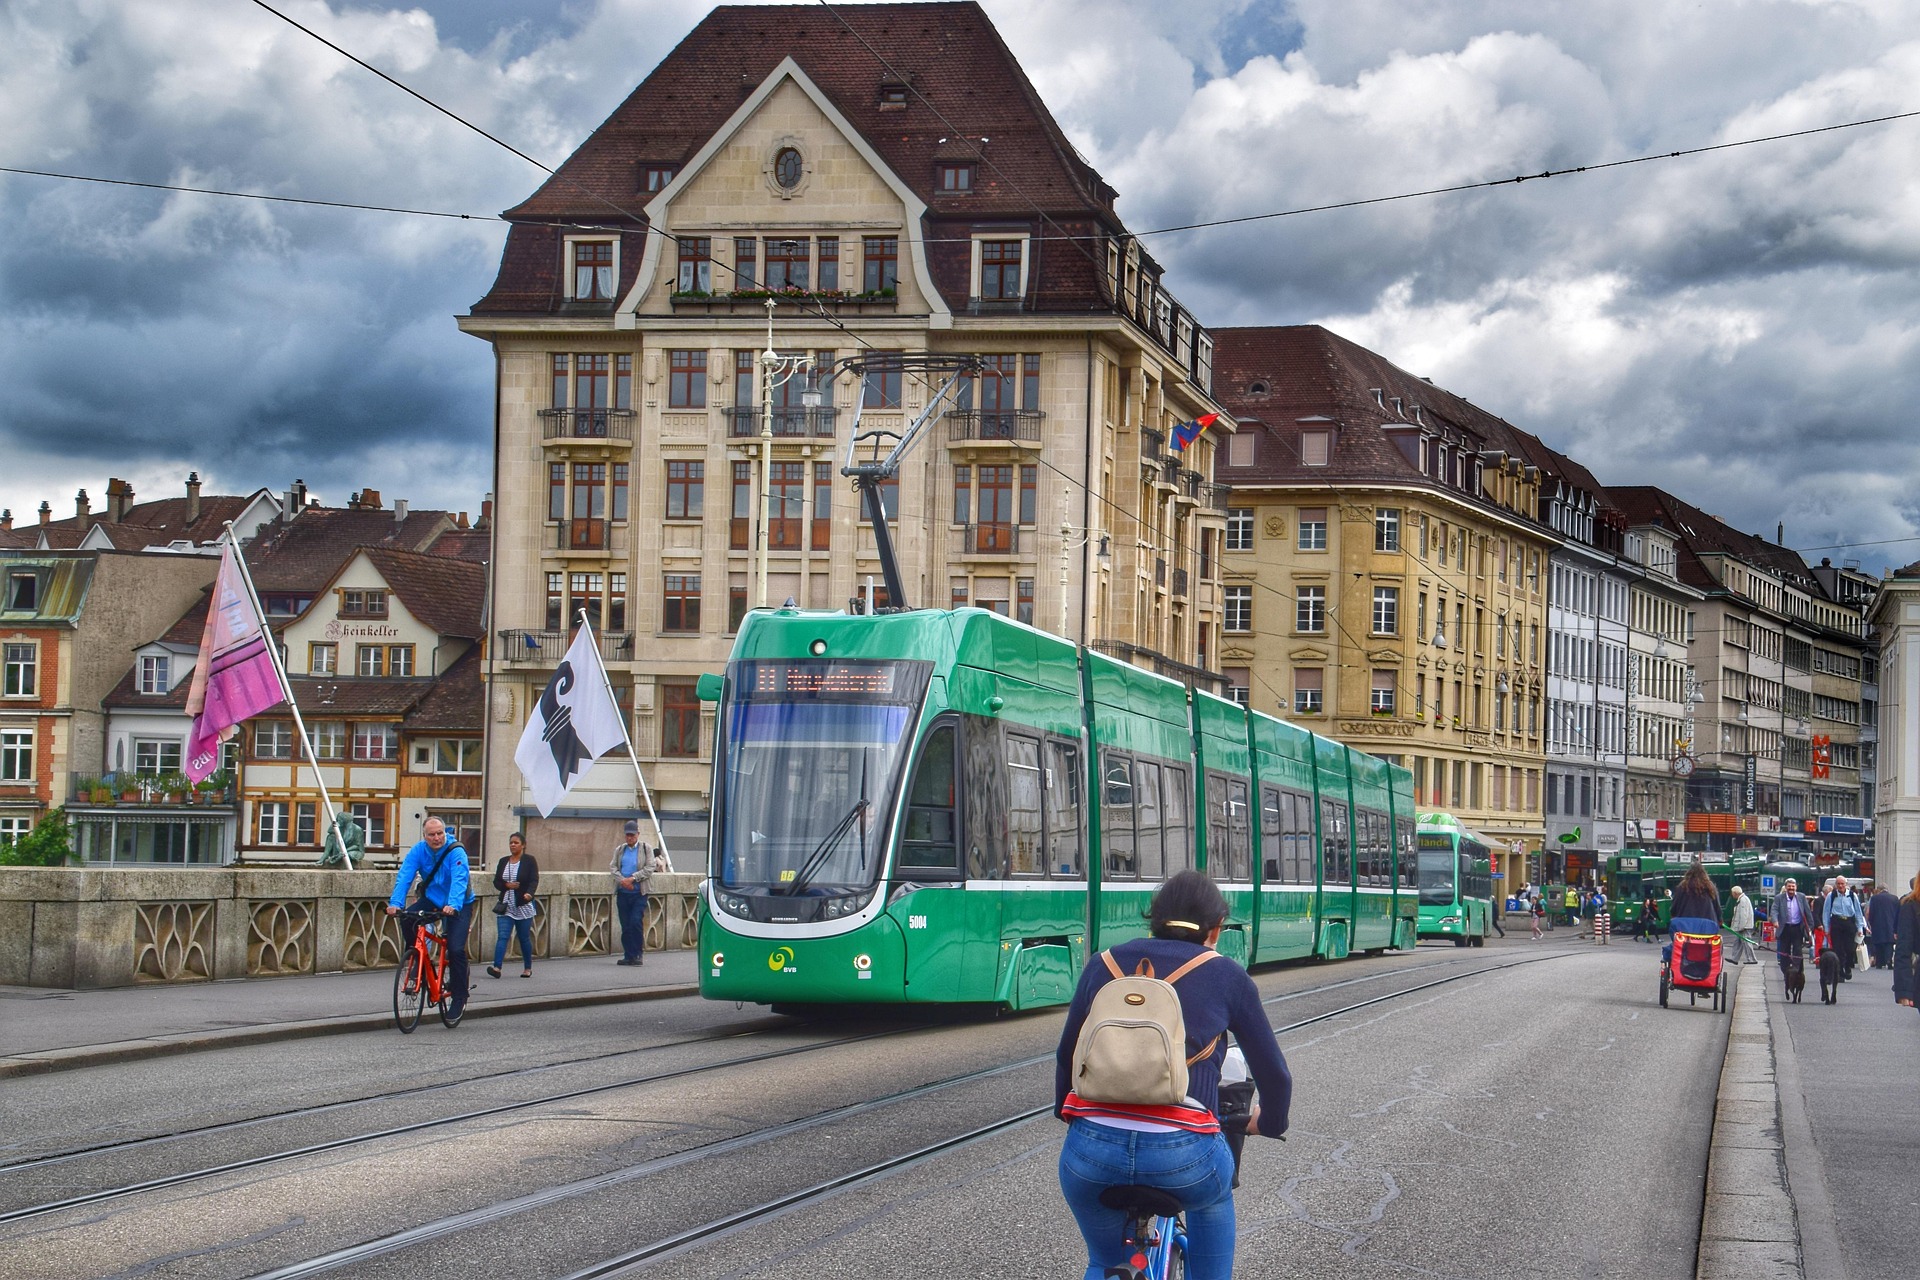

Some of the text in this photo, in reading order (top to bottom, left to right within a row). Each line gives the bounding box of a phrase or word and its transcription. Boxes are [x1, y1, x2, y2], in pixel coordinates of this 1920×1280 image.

[325, 620, 398, 640] Rheinkeller
[1746, 757, 1755, 810] McDonald's
[1626, 858, 1633, 866] 14
[909, 915, 927, 929] 5004
